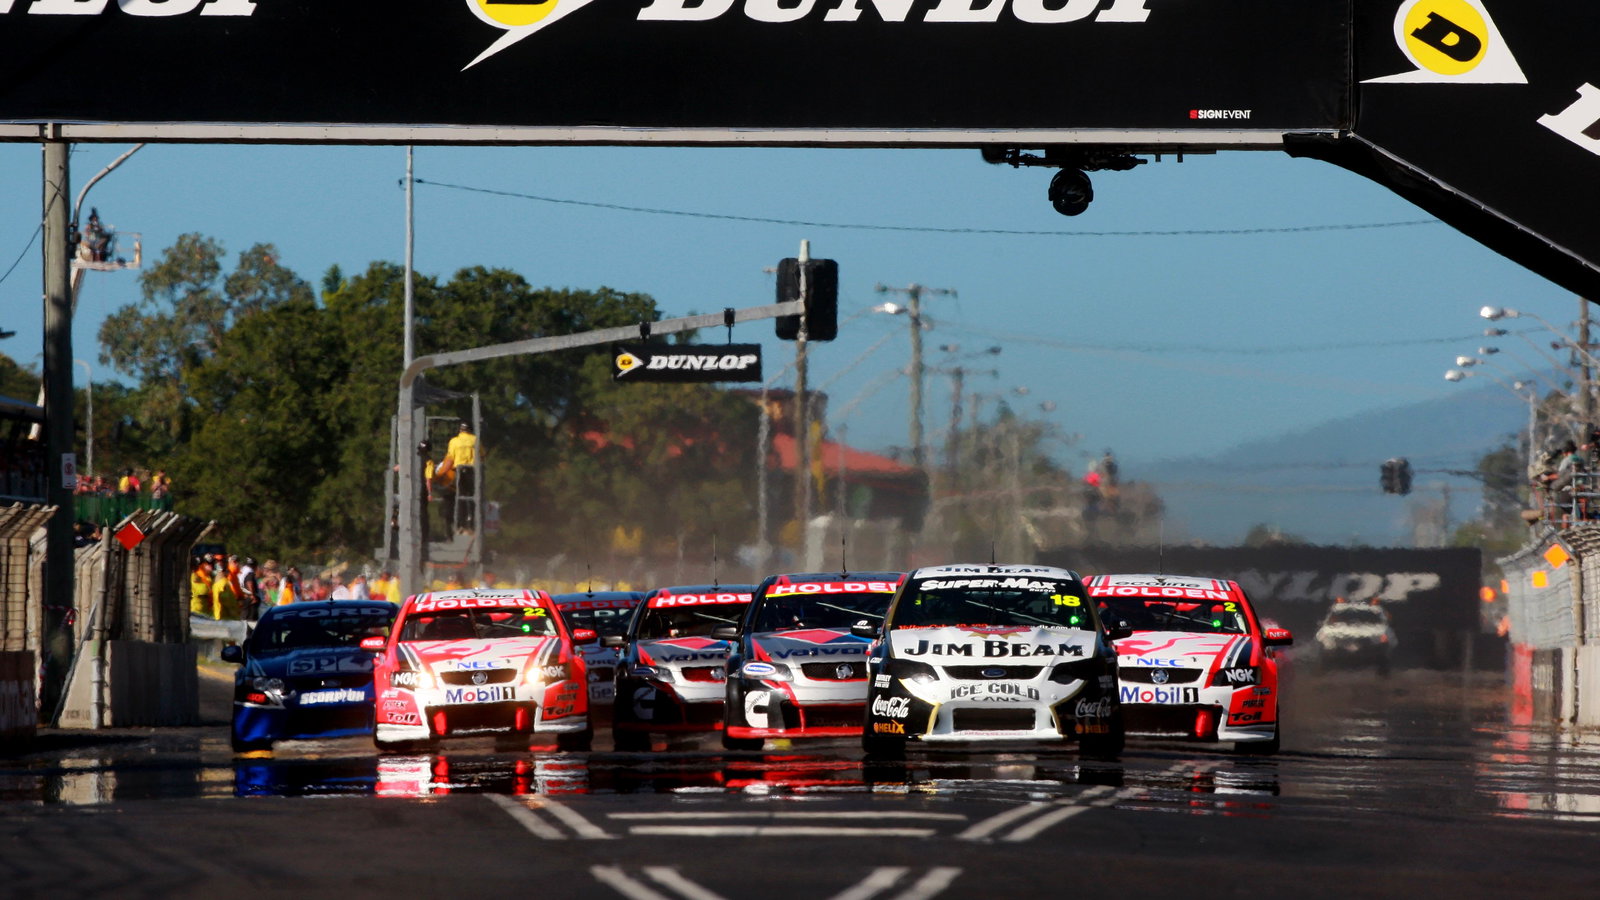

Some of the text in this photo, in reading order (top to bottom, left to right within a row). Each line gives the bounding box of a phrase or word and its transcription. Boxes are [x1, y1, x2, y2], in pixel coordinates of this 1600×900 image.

[646, 355, 758, 370] DUNLOP
[919, 578, 1058, 590] SUPER-MAX
[655, 593, 753, 607] HOLDE
[1092, 587, 1230, 600] HOLDEN
[416, 598, 539, 611] HOLDEN
[1050, 594, 1081, 607] 18
[1223, 602, 1237, 612] 2
[273, 608, 389, 620] FORD
[523, 607, 546, 617] 22
[904, 640, 1084, 658] JIM BEAM
[457, 661, 500, 669] NEC
[1136, 658, 1185, 667] NEC
[543, 665, 566, 678] NGK
[1225, 668, 1255, 682] NGK
[300, 689, 366, 704] SCORPION
[446, 687, 501, 703] Mobil
[951, 682, 1040, 701] ICE COLD
[1120, 686, 1180, 704] Mobil
[544, 704, 575, 716] Toll
[1231, 711, 1263, 722] Toll
[879, 719, 906, 735] HELIX
